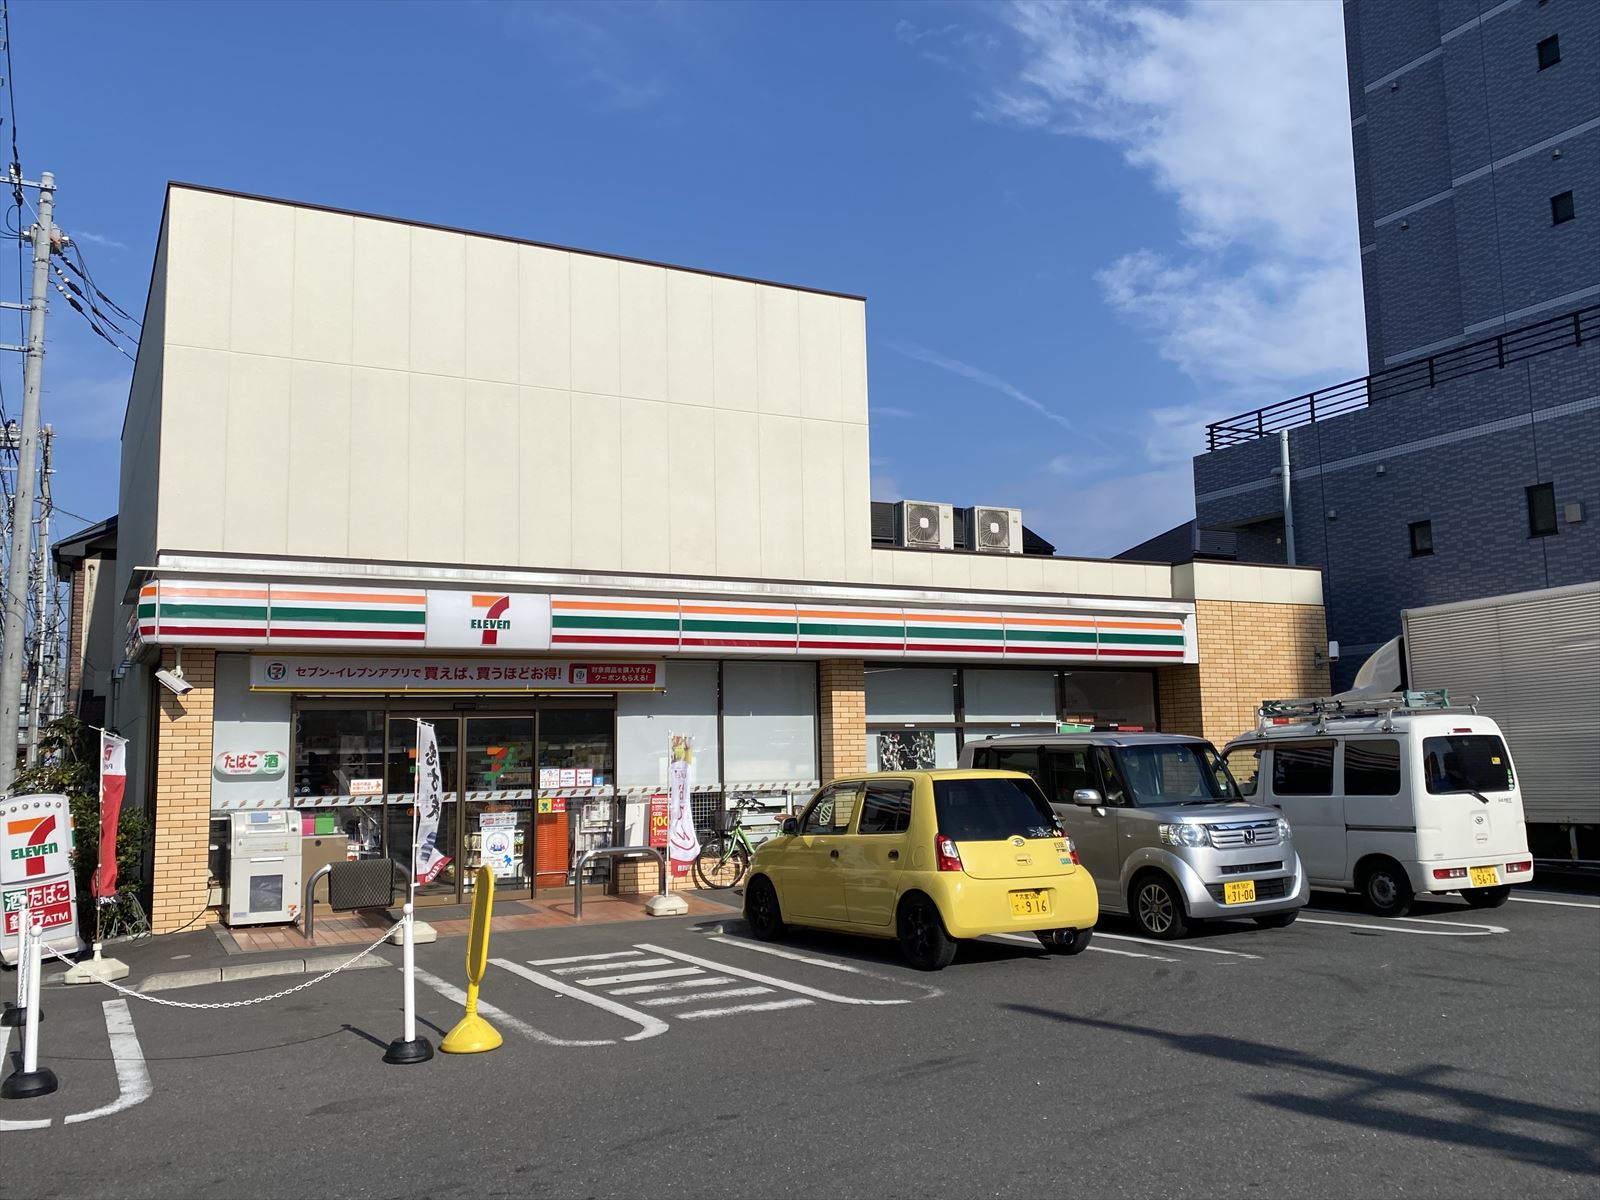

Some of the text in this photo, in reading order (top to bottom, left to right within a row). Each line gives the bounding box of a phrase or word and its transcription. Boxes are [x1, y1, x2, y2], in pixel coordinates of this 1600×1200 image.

[224, 754, 279, 769] たばこ 酒
[29, 884, 68, 907] たばこ
